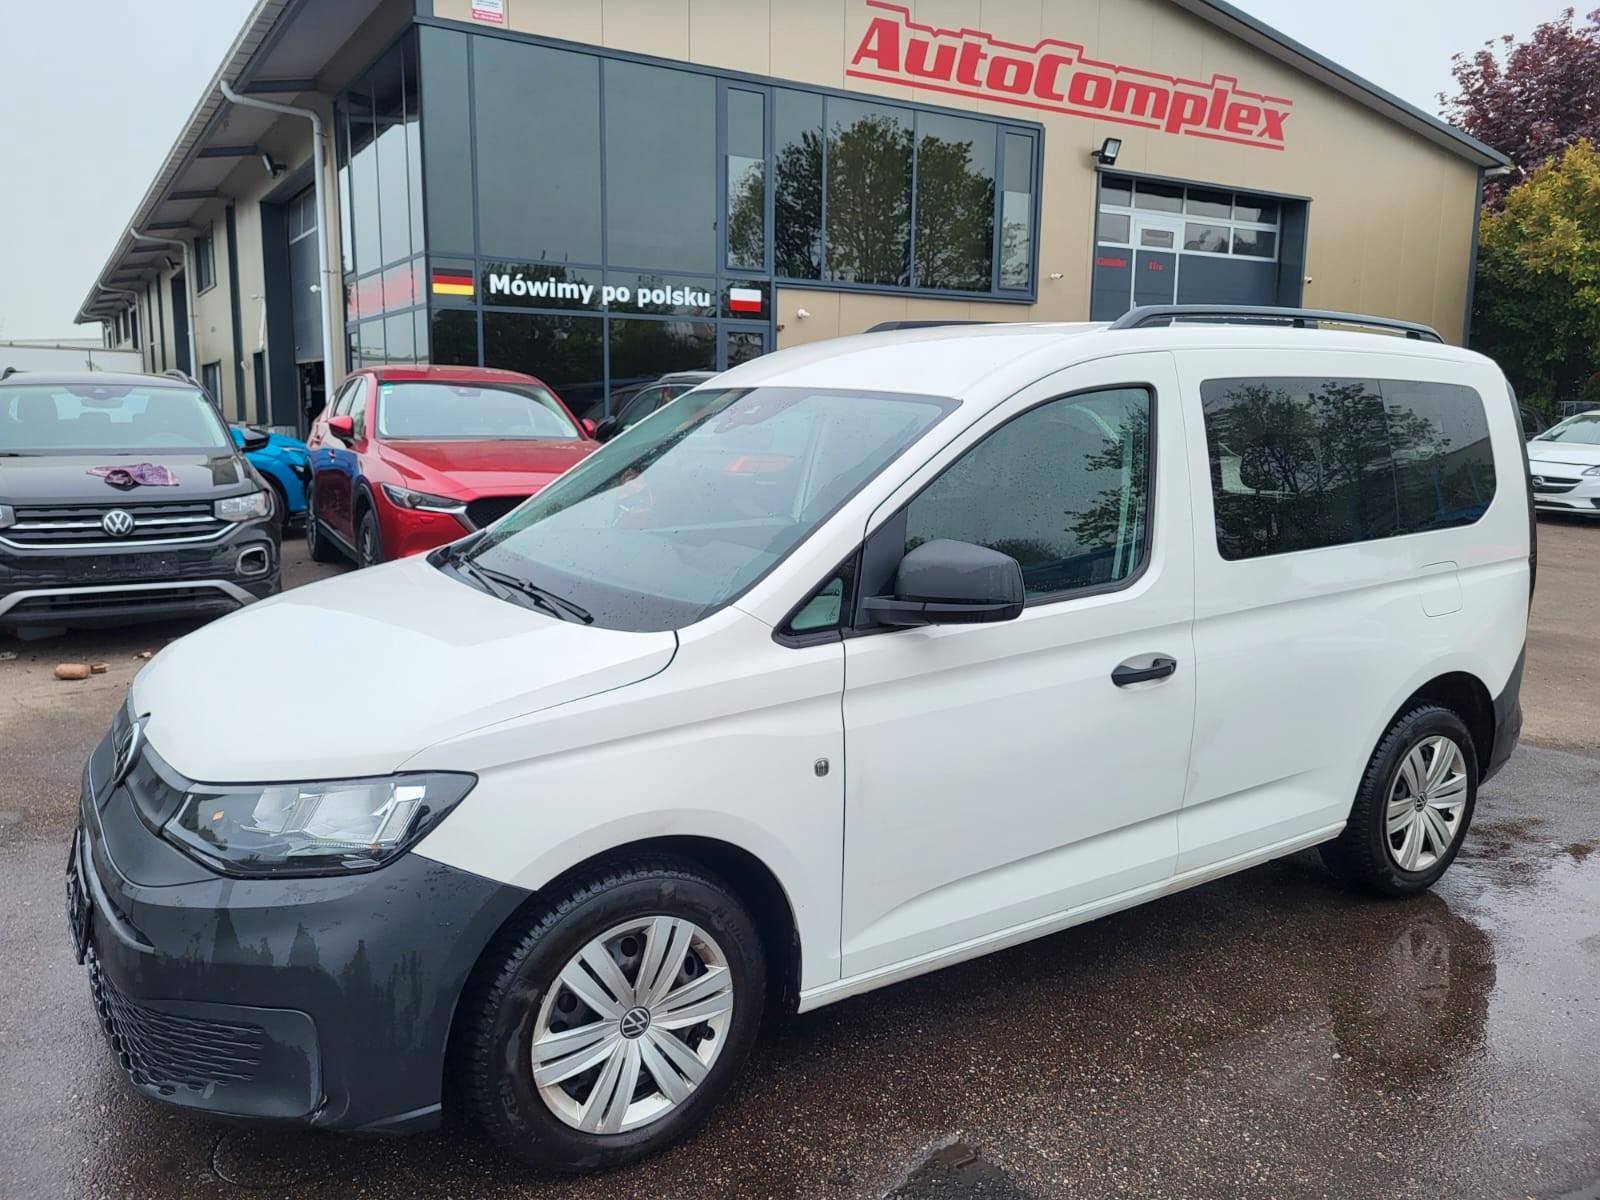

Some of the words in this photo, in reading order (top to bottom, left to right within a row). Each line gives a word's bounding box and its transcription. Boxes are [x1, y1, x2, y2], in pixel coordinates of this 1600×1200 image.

[851, 17, 1290, 141] AutoComplex
[489, 273, 594, 304] Mówimy
[602, 285, 631, 306] po
[638, 285, 711, 307] polsku
